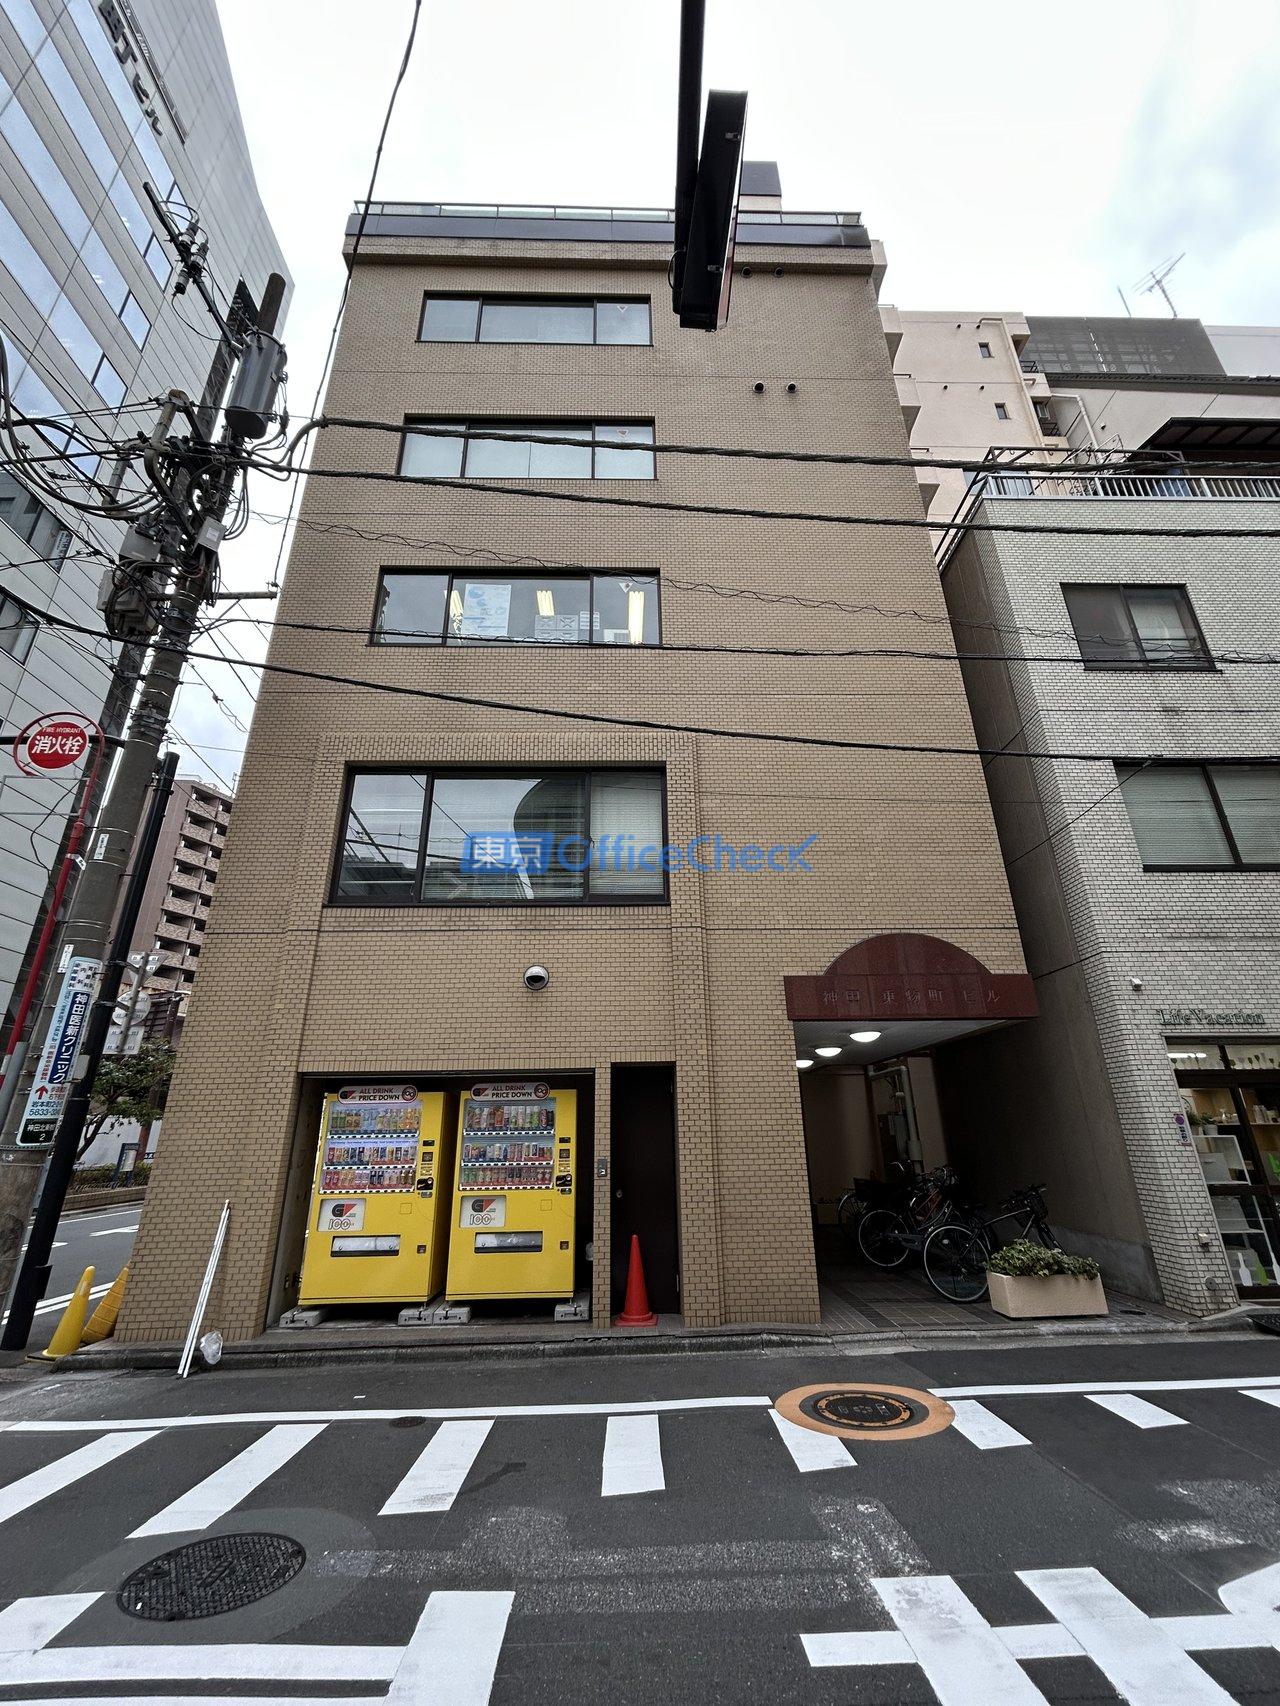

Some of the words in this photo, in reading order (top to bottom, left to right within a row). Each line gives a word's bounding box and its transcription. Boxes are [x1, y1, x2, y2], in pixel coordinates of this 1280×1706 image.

[31, 735, 83, 755] 消火栓
[822, 989, 861, 1004] 神田
[53, 993, 88, 1083] 神田医新クリニック
[39, 1133, 46, 1141] 2
